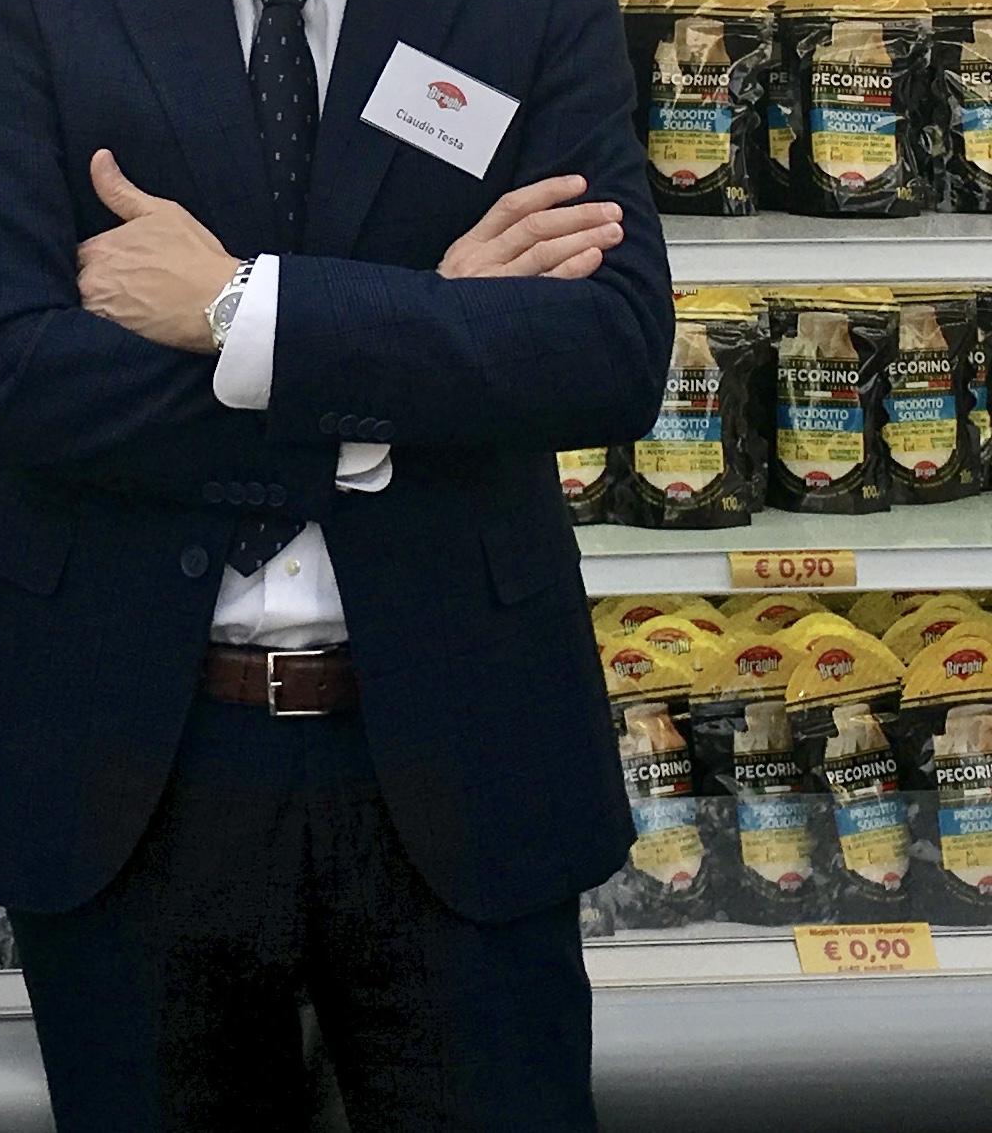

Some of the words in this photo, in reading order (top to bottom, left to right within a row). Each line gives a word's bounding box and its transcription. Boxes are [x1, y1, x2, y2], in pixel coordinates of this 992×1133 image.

[652, 73, 730, 86] PECORINO
[812, 73, 892, 88] PECORINO
[396, 108, 434, 135] Claudio
[438, 129, 464, 150] Testa
[778, 369, 858, 383] PECORINO
[755, 558, 771, 579] €
[779, 557, 835, 581] 0,90
[826, 759, 897, 784] PECORINO
[824, 941, 842, 961] €
[850, 938, 910, 963] 0,90
